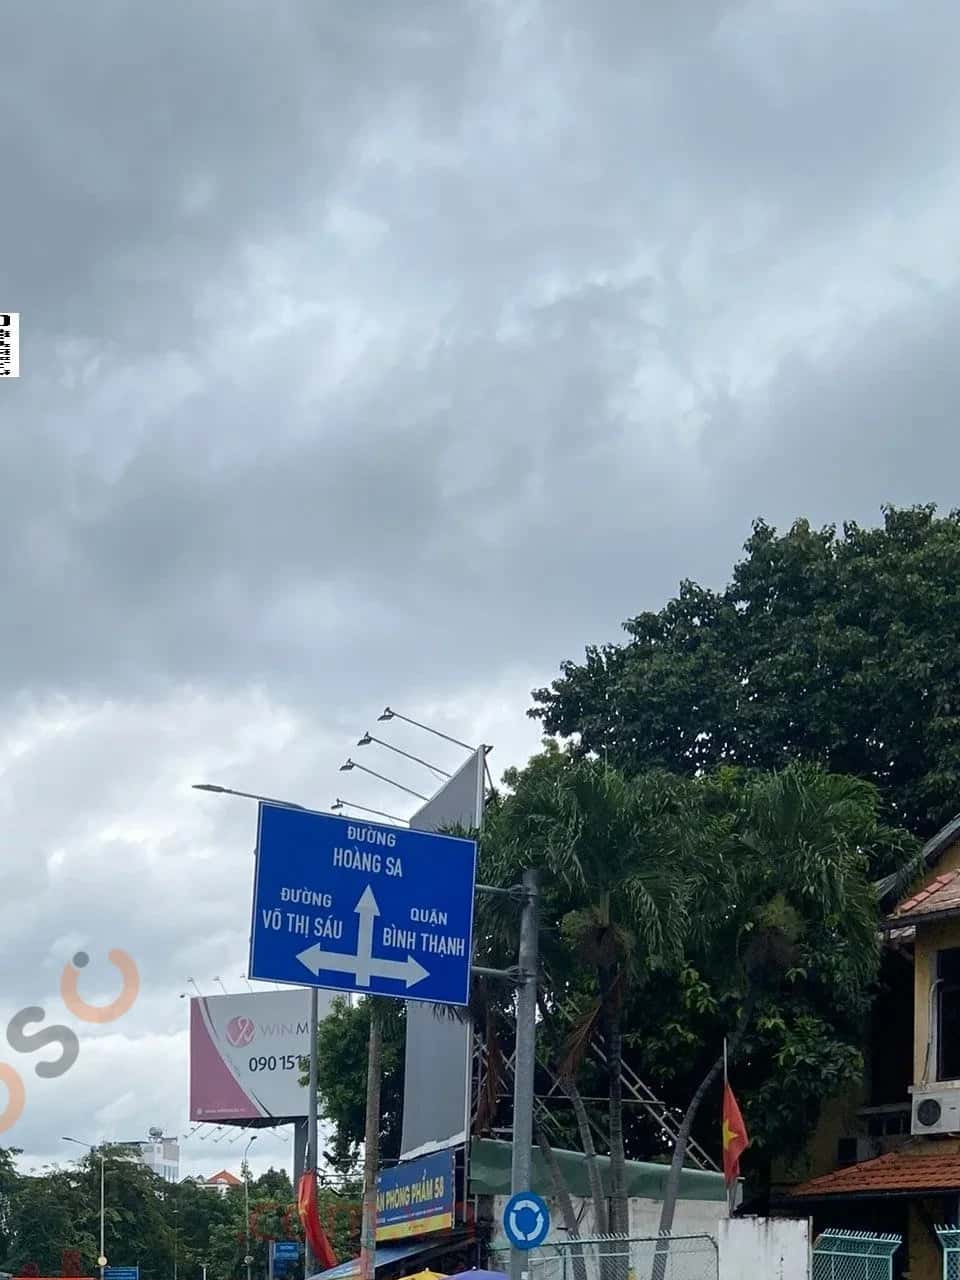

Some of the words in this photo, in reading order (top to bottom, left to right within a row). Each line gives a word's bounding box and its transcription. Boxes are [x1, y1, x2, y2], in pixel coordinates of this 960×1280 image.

[347, 825, 397, 847] ĐƯỜNG
[333, 845, 382, 873] HOÀNG
[385, 857, 403, 877] SA
[280, 887, 332, 908] ĐƯỜNG
[262, 908, 282, 930] VÕ
[287, 912, 310, 938] THỊ
[314, 914, 343, 940] SÁU
[410, 907, 448, 926] QUẬN
[383, 924, 416, 950] BÌNH
[421, 933, 465, 958] THẠNH
